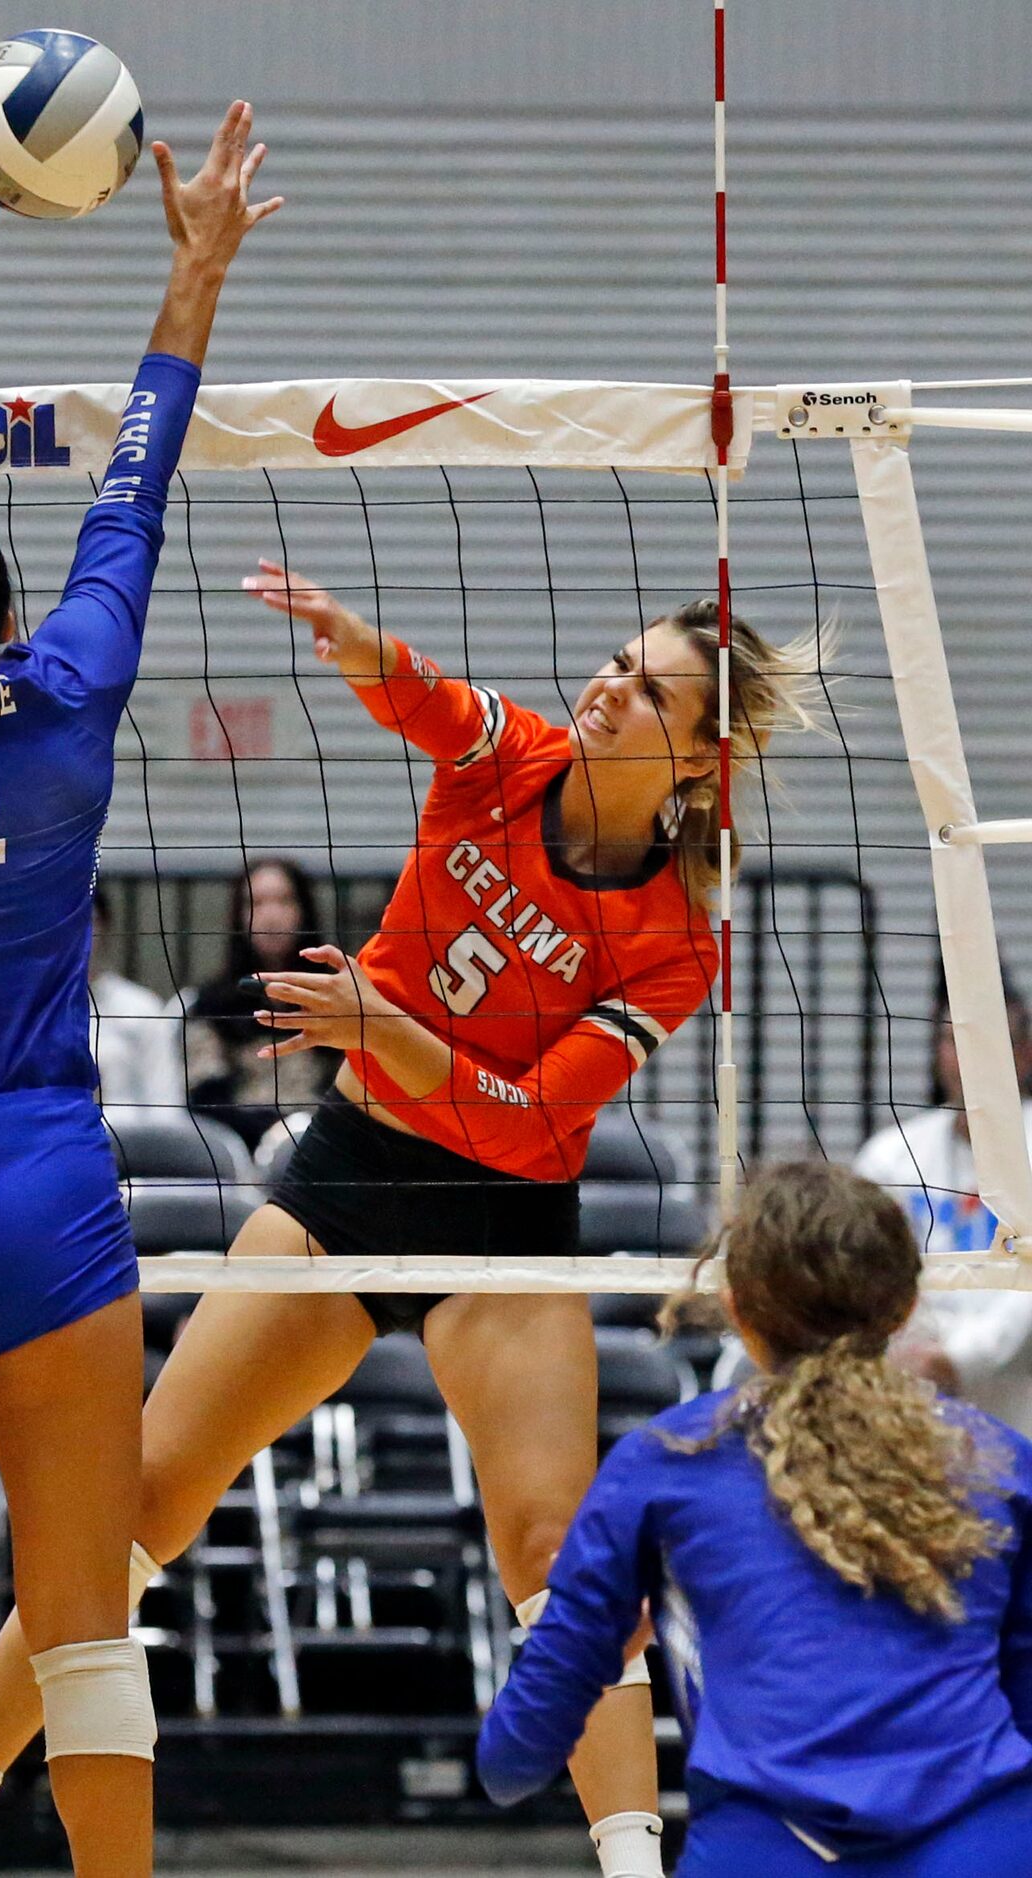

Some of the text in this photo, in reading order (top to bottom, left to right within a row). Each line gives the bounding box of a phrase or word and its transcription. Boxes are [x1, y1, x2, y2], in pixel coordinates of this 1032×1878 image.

[819, 391, 877, 406] Senoh
[445, 839, 587, 985] CELINA
[428, 924, 508, 1017] 5
